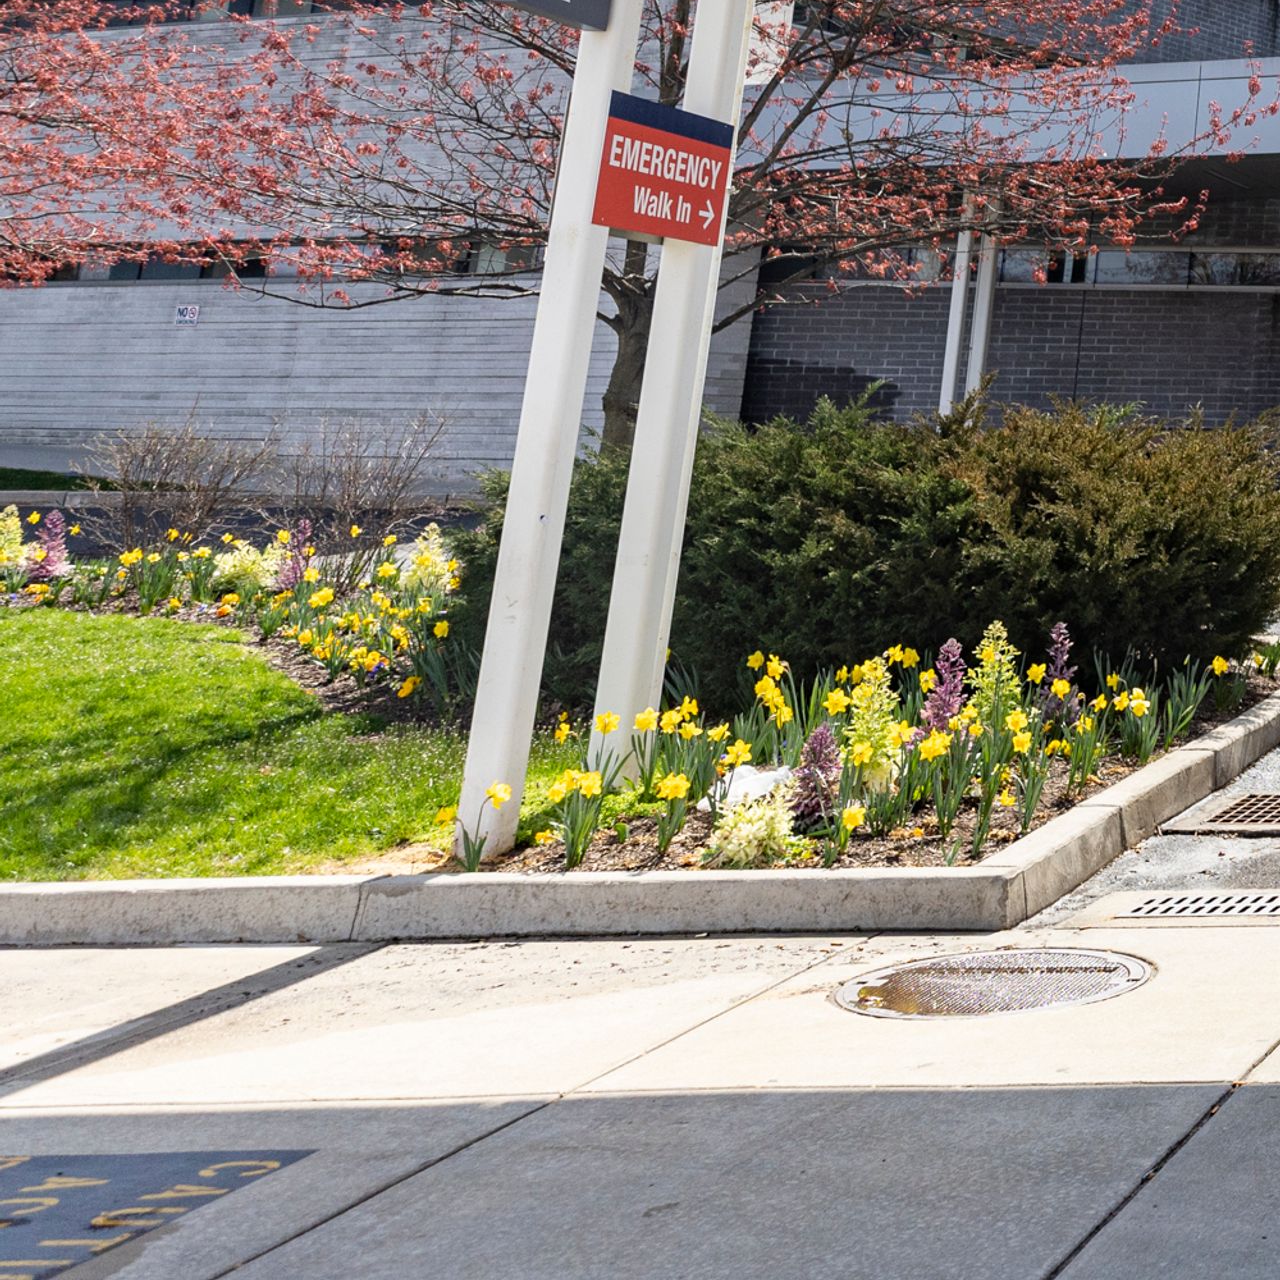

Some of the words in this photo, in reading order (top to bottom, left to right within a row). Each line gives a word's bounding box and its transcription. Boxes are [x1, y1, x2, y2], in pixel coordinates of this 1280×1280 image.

[609, 134, 723, 191] EMERGENCY
[633, 184, 674, 222] Walk
[673, 193, 692, 224] In
[177, 307, 188, 318] NO
